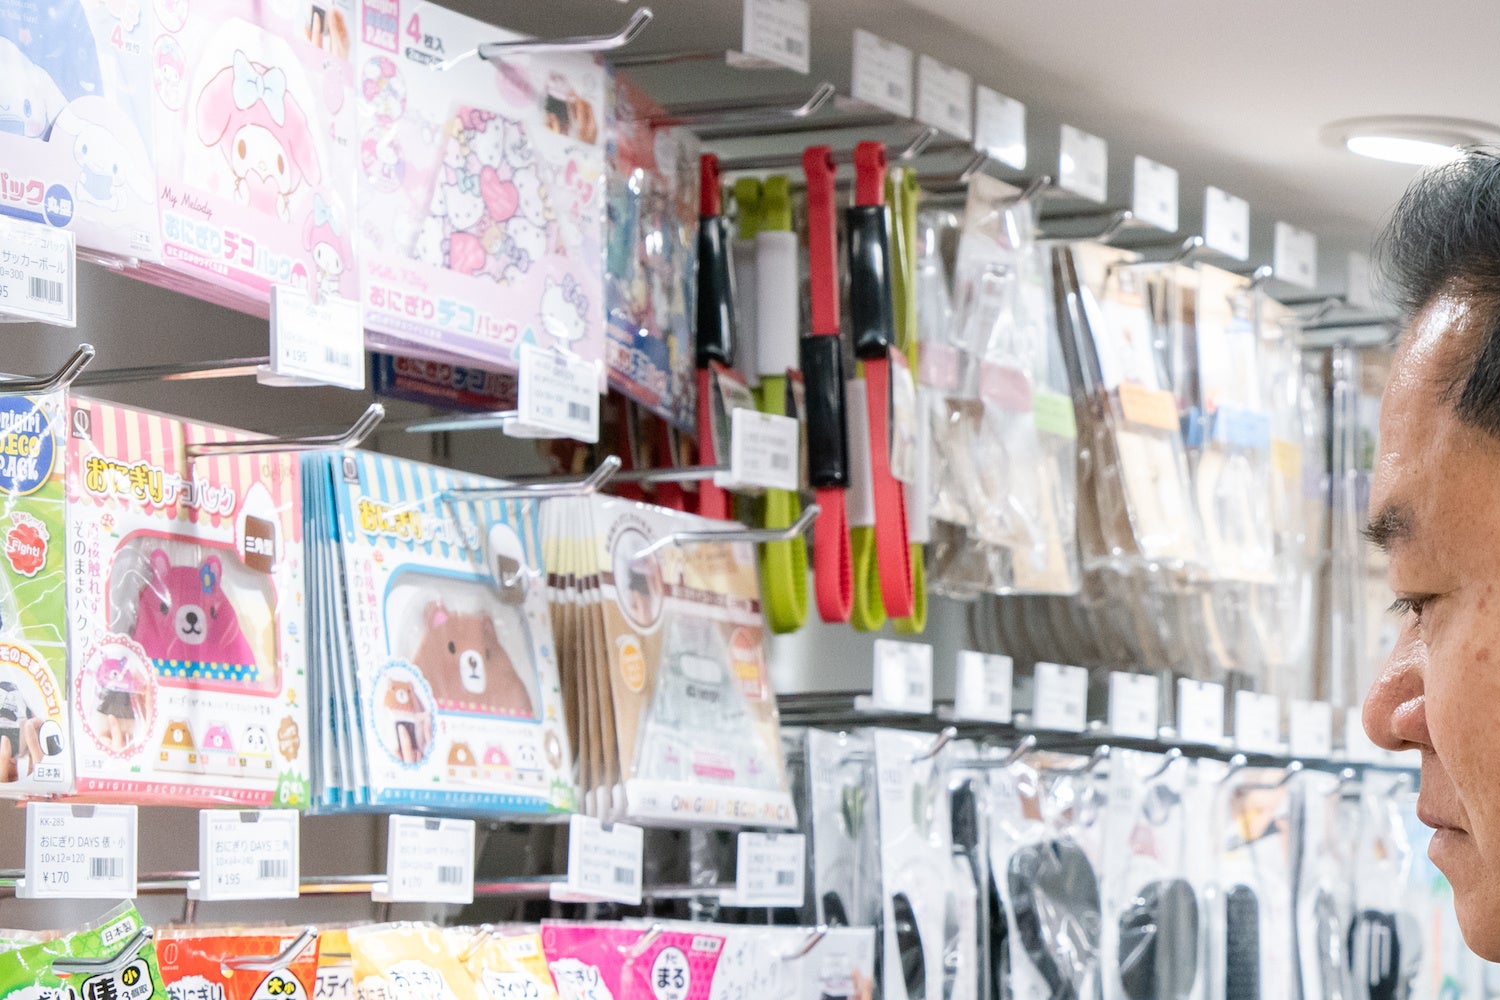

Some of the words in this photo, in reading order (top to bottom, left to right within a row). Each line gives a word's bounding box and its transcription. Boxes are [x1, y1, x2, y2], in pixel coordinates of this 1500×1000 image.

[161, 186, 178, 208] My
[180, 192, 213, 220] Melody
[2, 251, 66, 275] サッカーボール
[369, 284, 519, 345] おにぎりデコパック
[11, 539, 41, 557] Fight!
[36, 766, 61, 780] 日本製
[40, 835, 75, 849] おにぎり
[77, 836, 100, 848] DAYS
[250, 840, 272, 851] DAYS
[103, 920, 134, 943] 日本製
[124, 968, 138, 984] 小
[316, 975, 354, 998] スティ
[657, 967, 685, 989] まる
